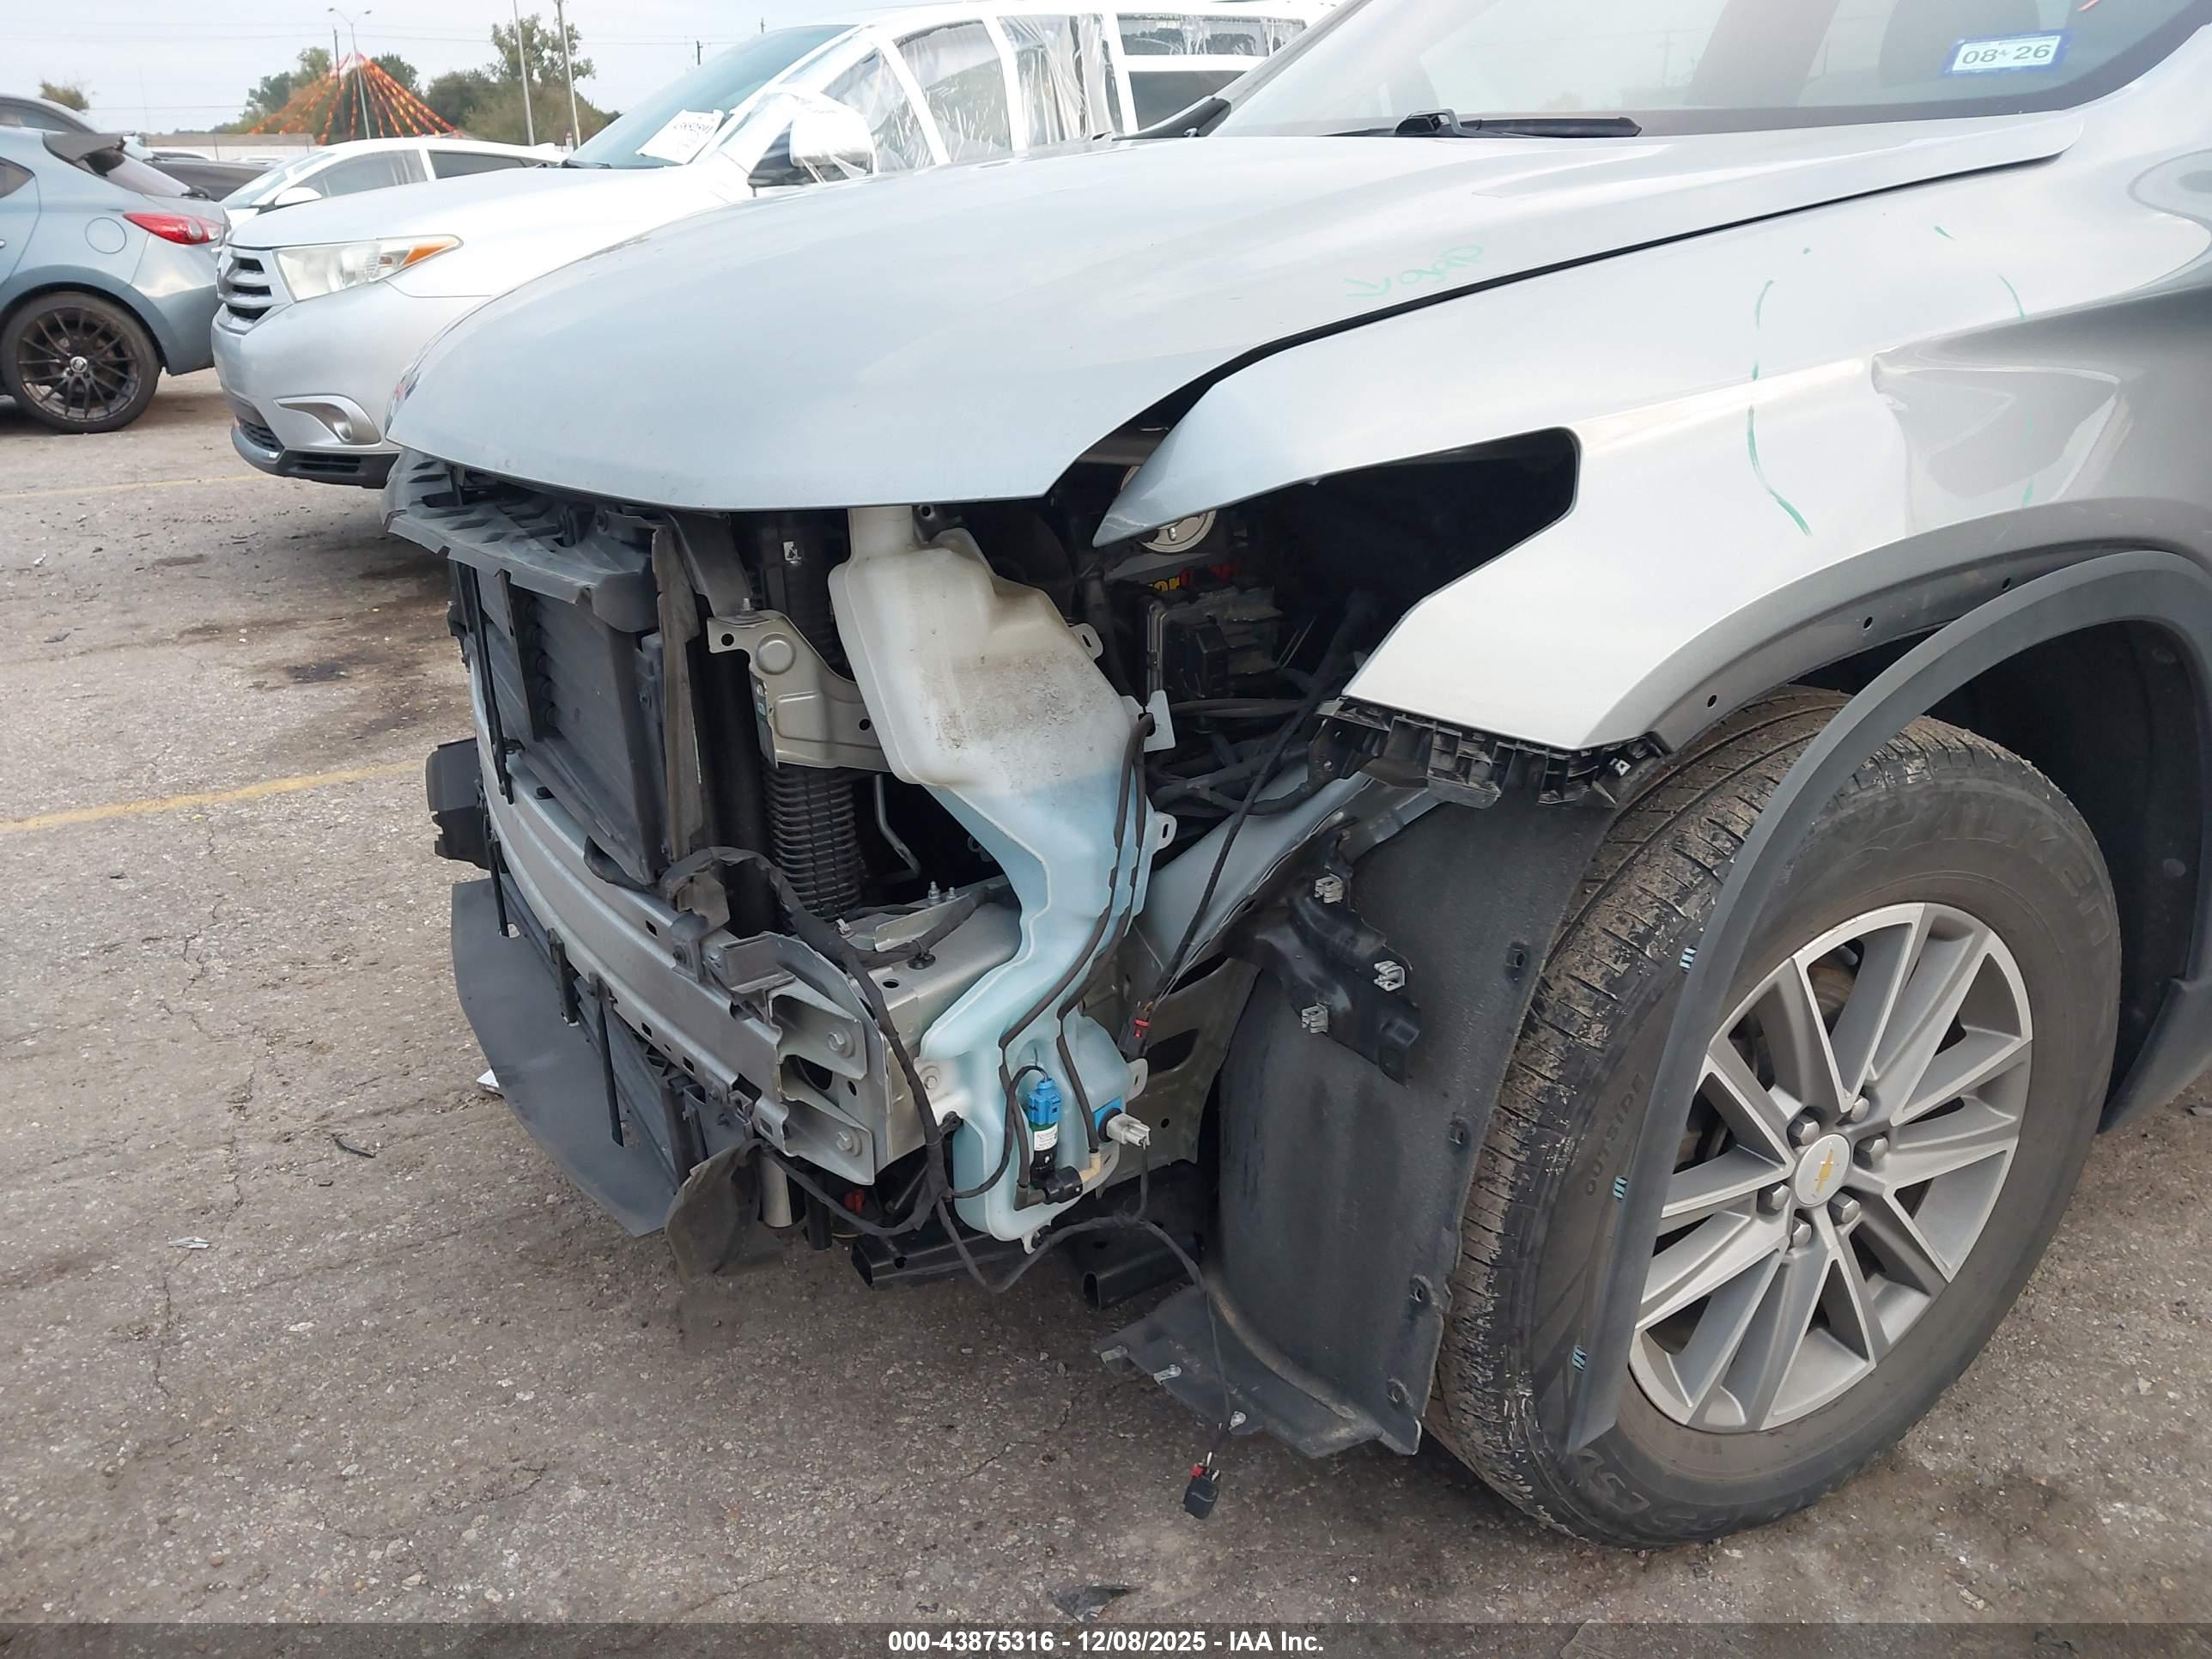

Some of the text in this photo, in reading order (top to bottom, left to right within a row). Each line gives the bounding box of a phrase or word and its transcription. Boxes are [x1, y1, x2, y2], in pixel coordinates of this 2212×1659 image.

[1962, 45, 2051, 64] 08 26
[1585, 1074, 1644, 1195] OUTSIDE
